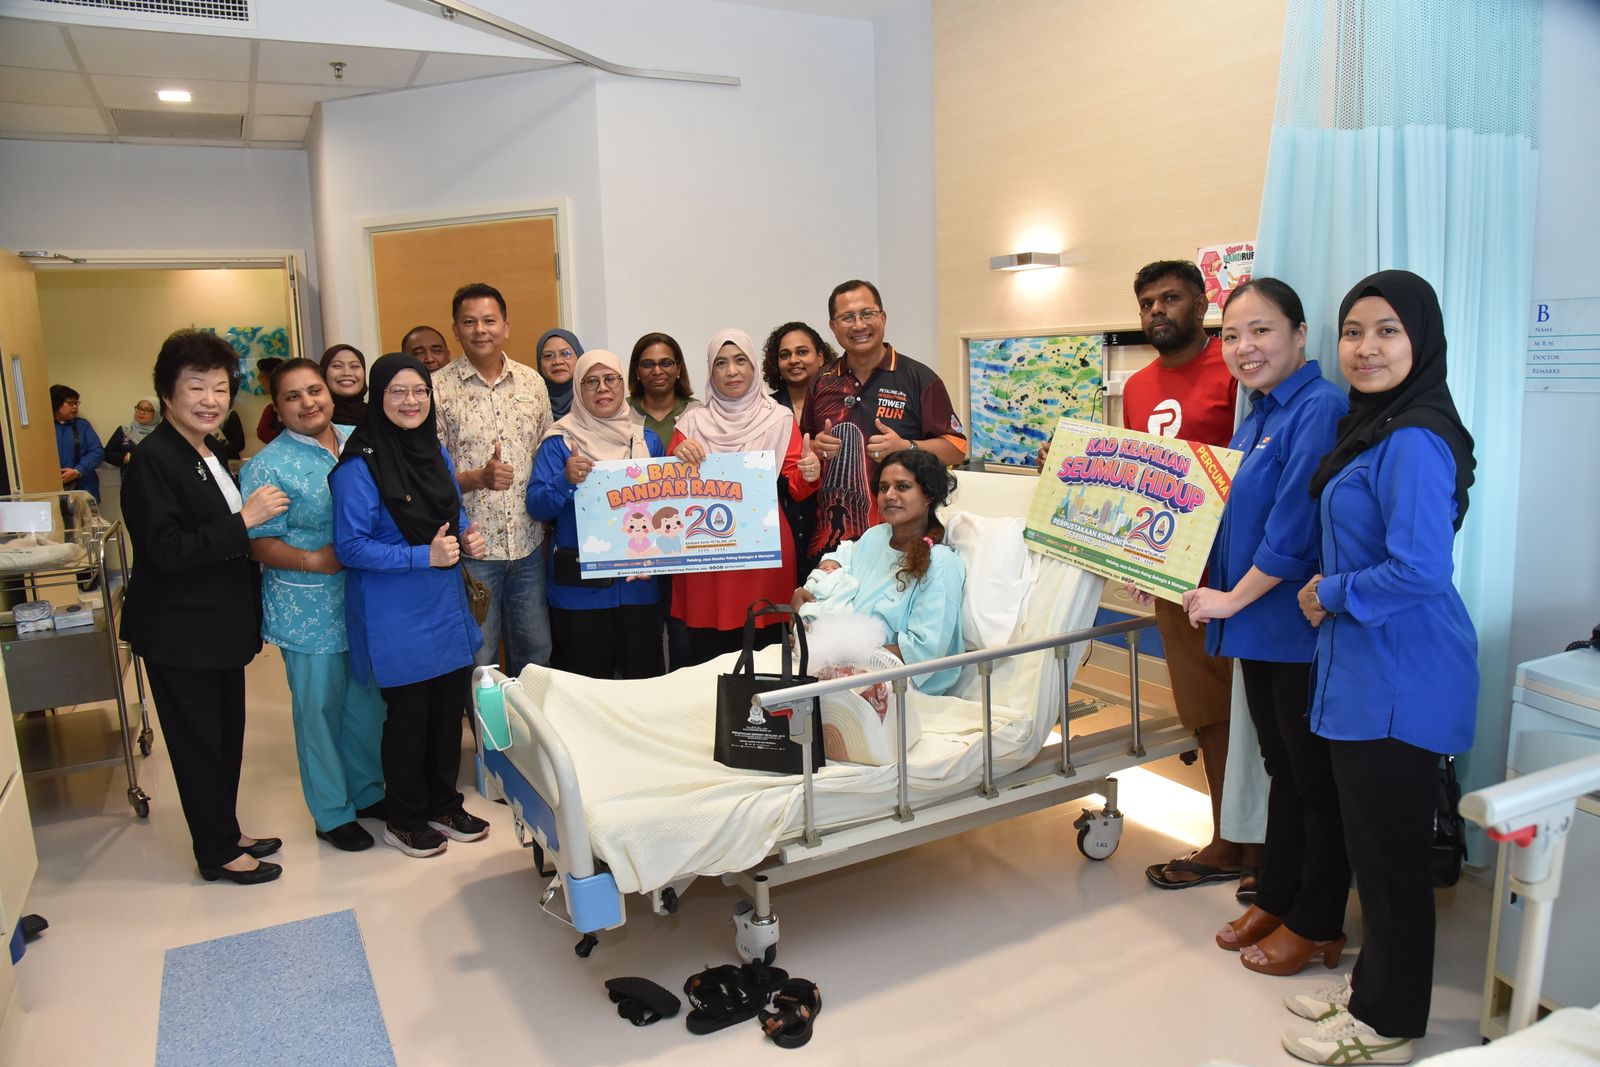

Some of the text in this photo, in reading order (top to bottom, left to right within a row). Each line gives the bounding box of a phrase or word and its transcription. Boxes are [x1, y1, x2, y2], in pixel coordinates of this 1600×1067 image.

[1225, 244, 1254, 256] How to
[1536, 304, 1550, 323] B
[876, 407, 905, 420] RUN
[878, 398, 906, 409] TOWER
[647, 462, 701, 481] BAYI
[1085, 437, 1192, 477] KAD KEAHLIAN
[1197, 445, 1230, 496] PERCUMA
[606, 479, 743, 508] BANDAR RAYA
[1057, 457, 1206, 513] SEUMUR HIDUP
[685, 503, 735, 540] 20
[1053, 518, 1098, 537] PERPUSTAKAAN
[1097, 531, 1126, 547] KOMUNI
[1126, 506, 1175, 548] 20
